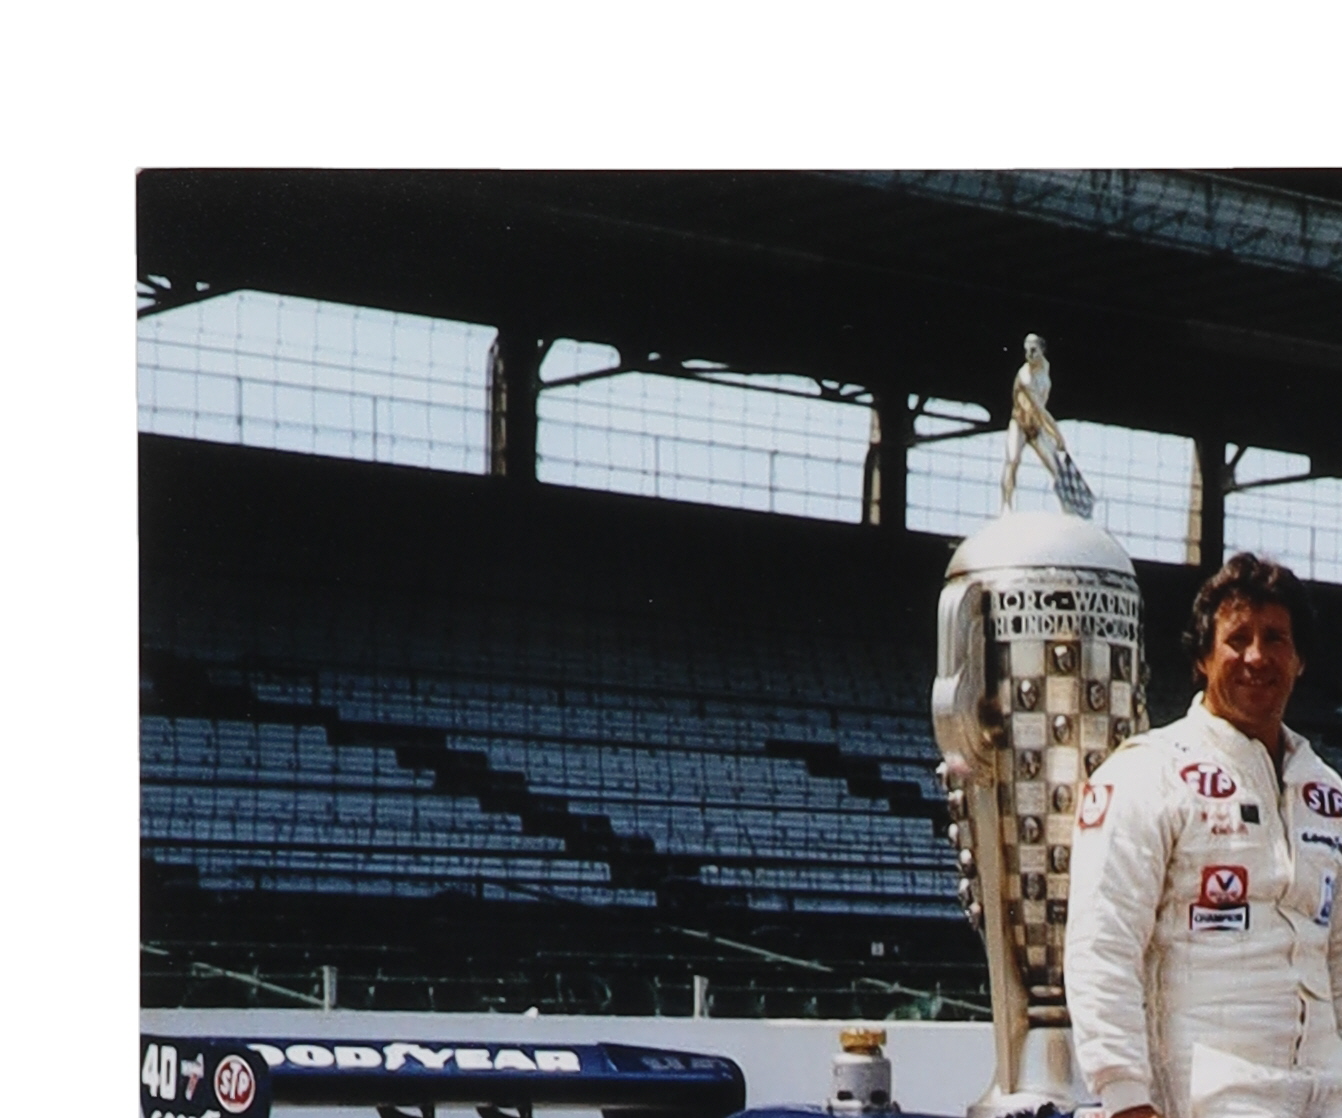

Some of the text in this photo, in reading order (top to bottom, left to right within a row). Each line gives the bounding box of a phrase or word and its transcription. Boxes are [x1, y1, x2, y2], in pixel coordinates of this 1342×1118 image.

[142, 1043, 178, 1100] 40
[246, 1043, 581, 1072] OODYEAR
[219, 1061, 250, 1100] STP
